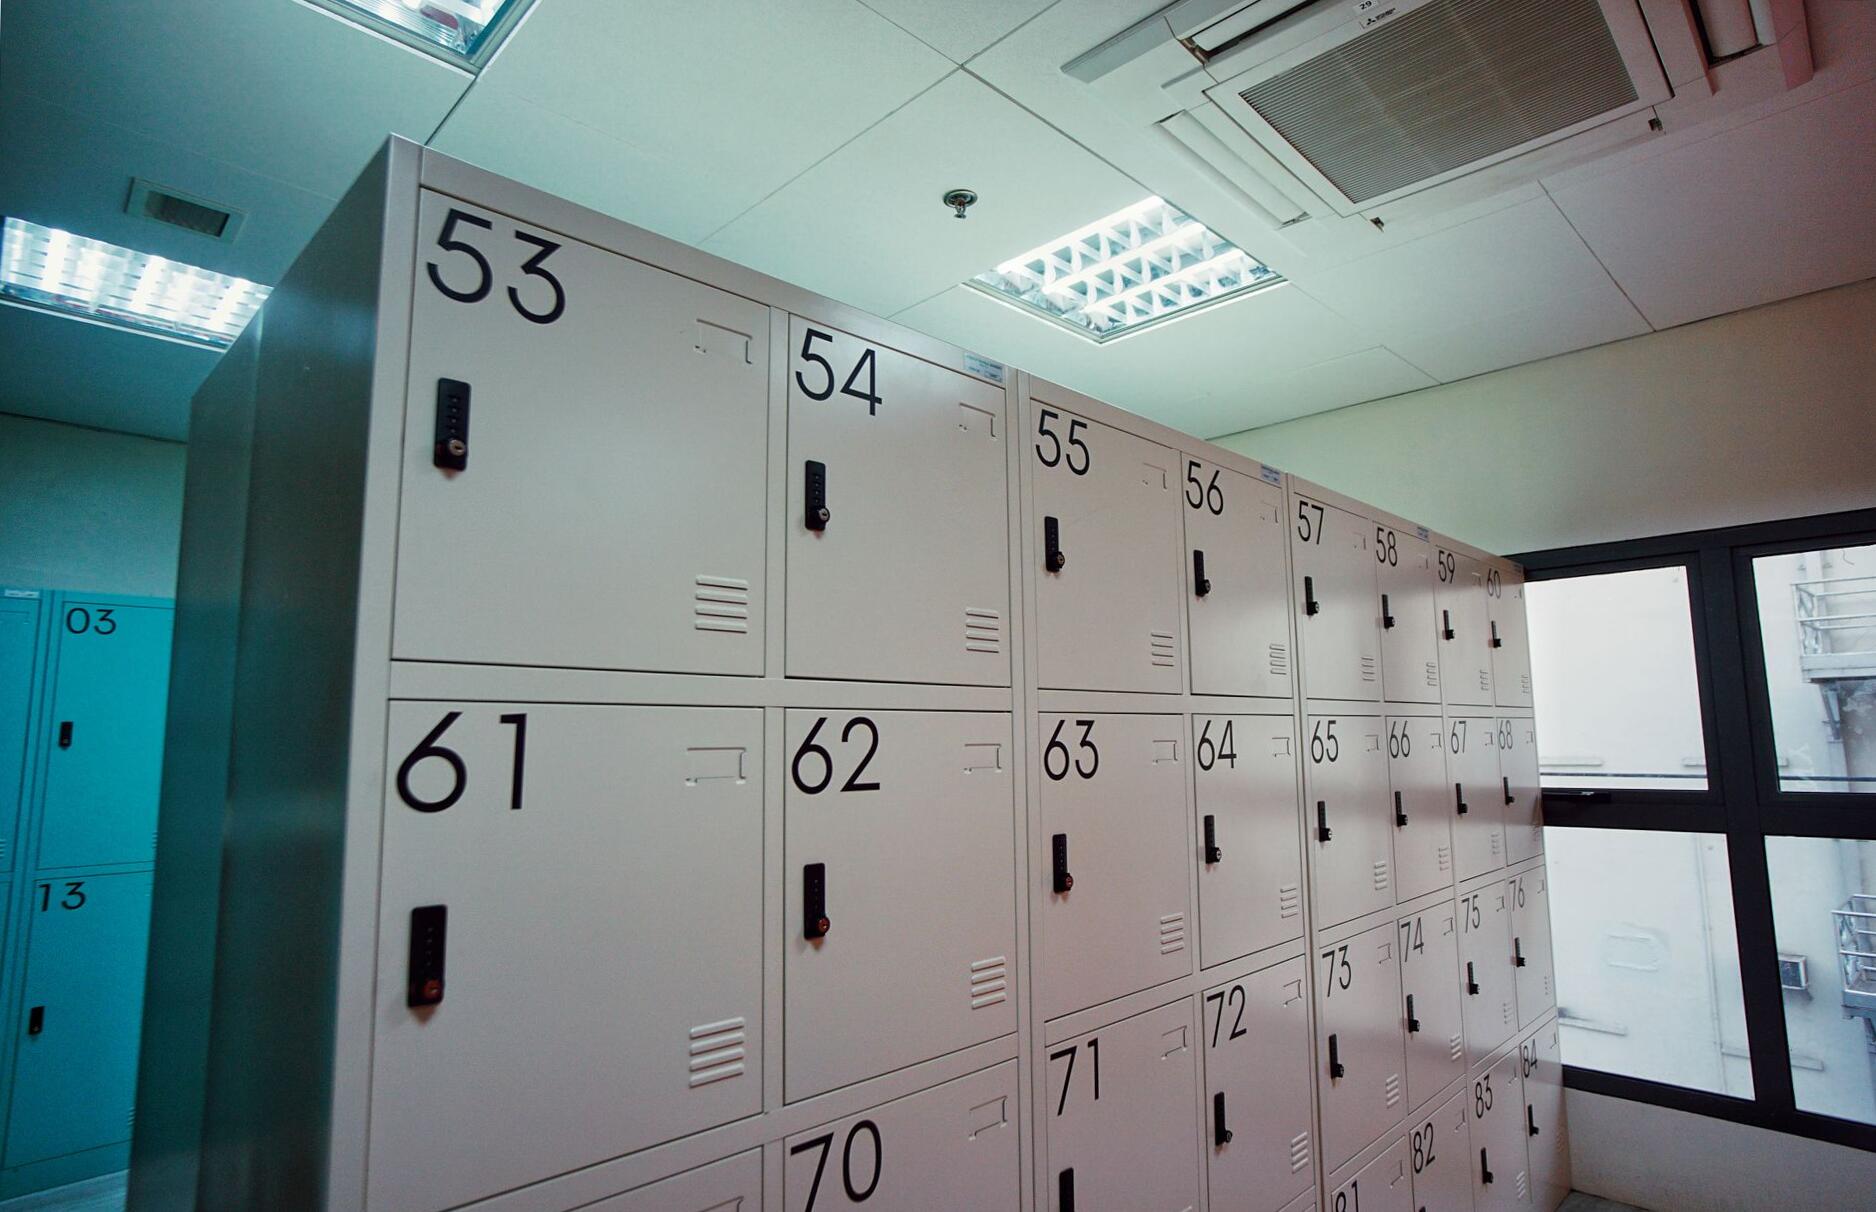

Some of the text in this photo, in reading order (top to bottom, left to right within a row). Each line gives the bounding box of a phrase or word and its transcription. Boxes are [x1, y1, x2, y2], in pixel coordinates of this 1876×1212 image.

[1360, 0, 1372, 10] 29
[426, 209, 565, 325] 53
[795, 328, 883, 416] 54
[1036, 409, 1091, 475] 55
[1186, 461, 1224, 516] 56
[1298, 500, 1324, 544] 57
[1376, 527, 1397, 567] 58
[1439, 550, 1455, 583] 59
[1487, 568, 1501, 599] 60
[66, 608, 116, 635] 03
[792, 717, 880, 794] 62
[1044, 720, 1098, 781] 63
[1198, 720, 1236, 771] 64
[1311, 720, 1338, 763] 65
[1390, 721, 1410, 758] 66
[1451, 721, 1466, 754] 67
[1499, 720, 1513, 750] 68
[396, 711, 527, 813] 61
[39, 882, 85, 911] 13
[1461, 894, 1481, 934] 75
[1509, 877, 1525, 912] 76
[1401, 917, 1424, 962] 74
[1322, 945, 1352, 997] 73
[1206, 985, 1247, 1049] 72
[1050, 1038, 1100, 1117] 71
[1523, 1039, 1538, 1079] 84
[1475, 1074, 1493, 1119] 83
[791, 1120, 882, 1212] 70
[1413, 1122, 1436, 1174] 82
